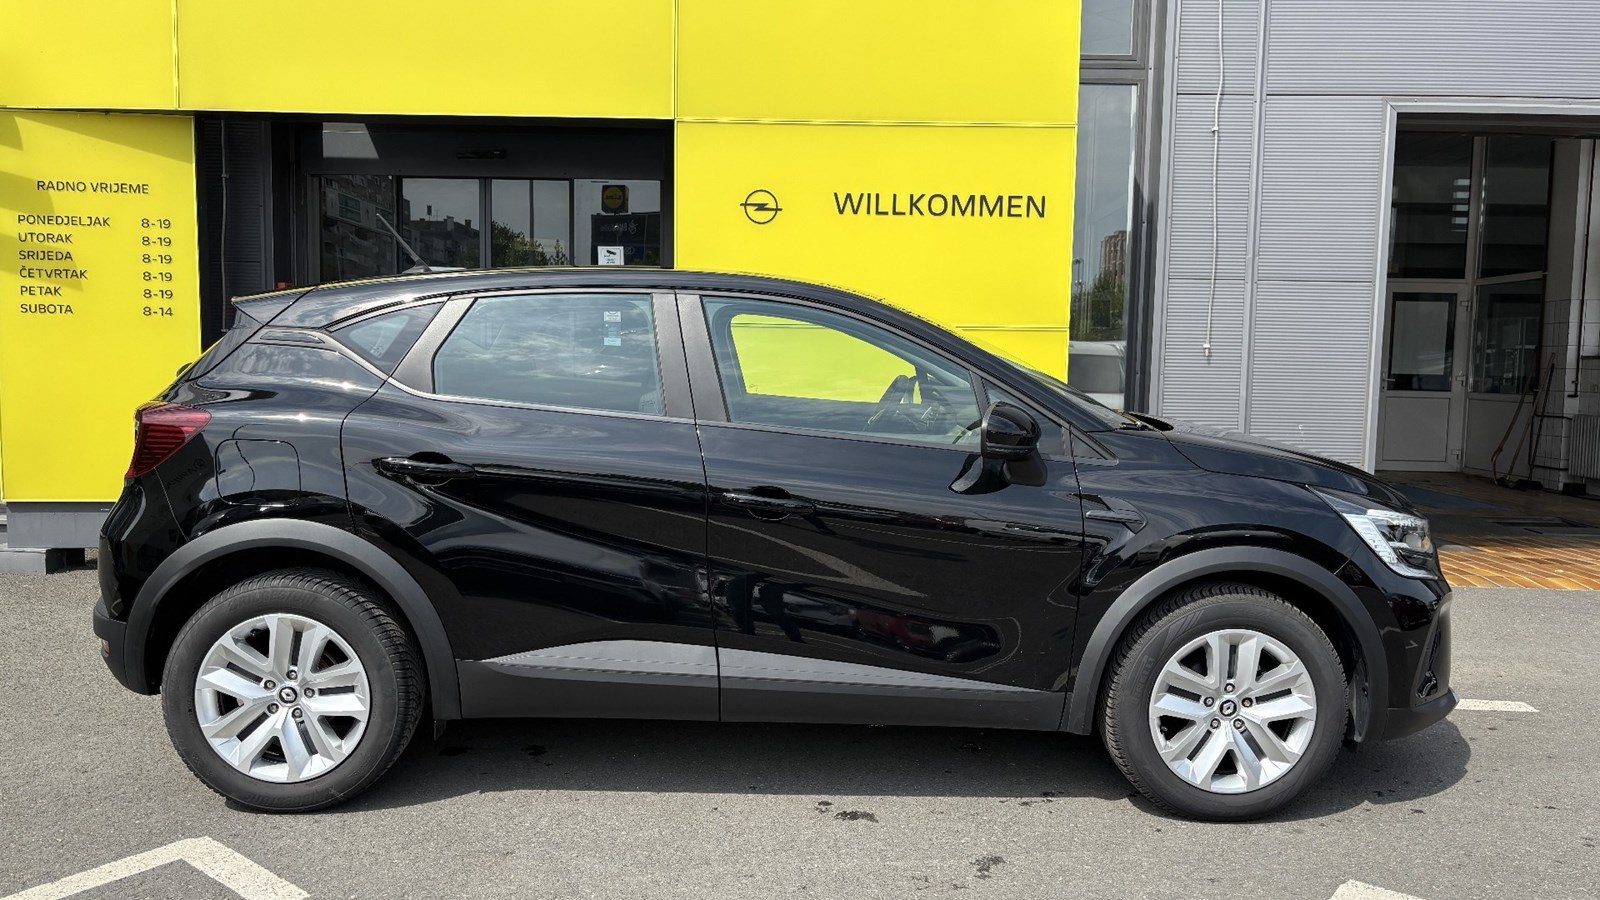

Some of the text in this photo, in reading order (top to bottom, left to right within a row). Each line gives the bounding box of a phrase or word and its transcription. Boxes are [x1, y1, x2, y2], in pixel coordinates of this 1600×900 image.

[37, 181, 149, 194] RADNO VRIJEME
[834, 192, 1045, 218] WILLKOMMEN
[18, 215, 171, 229] PONEDJELJAK 8-19
[19, 233, 171, 247] UTORAK 8-19
[19, 250, 172, 264] SRIJEDA 8-19
[20, 265, 172, 283] ČETVRTAK 8-19
[21, 286, 173, 300] PETAK 8-19
[21, 304, 173, 316] SUBOTA 8-14
